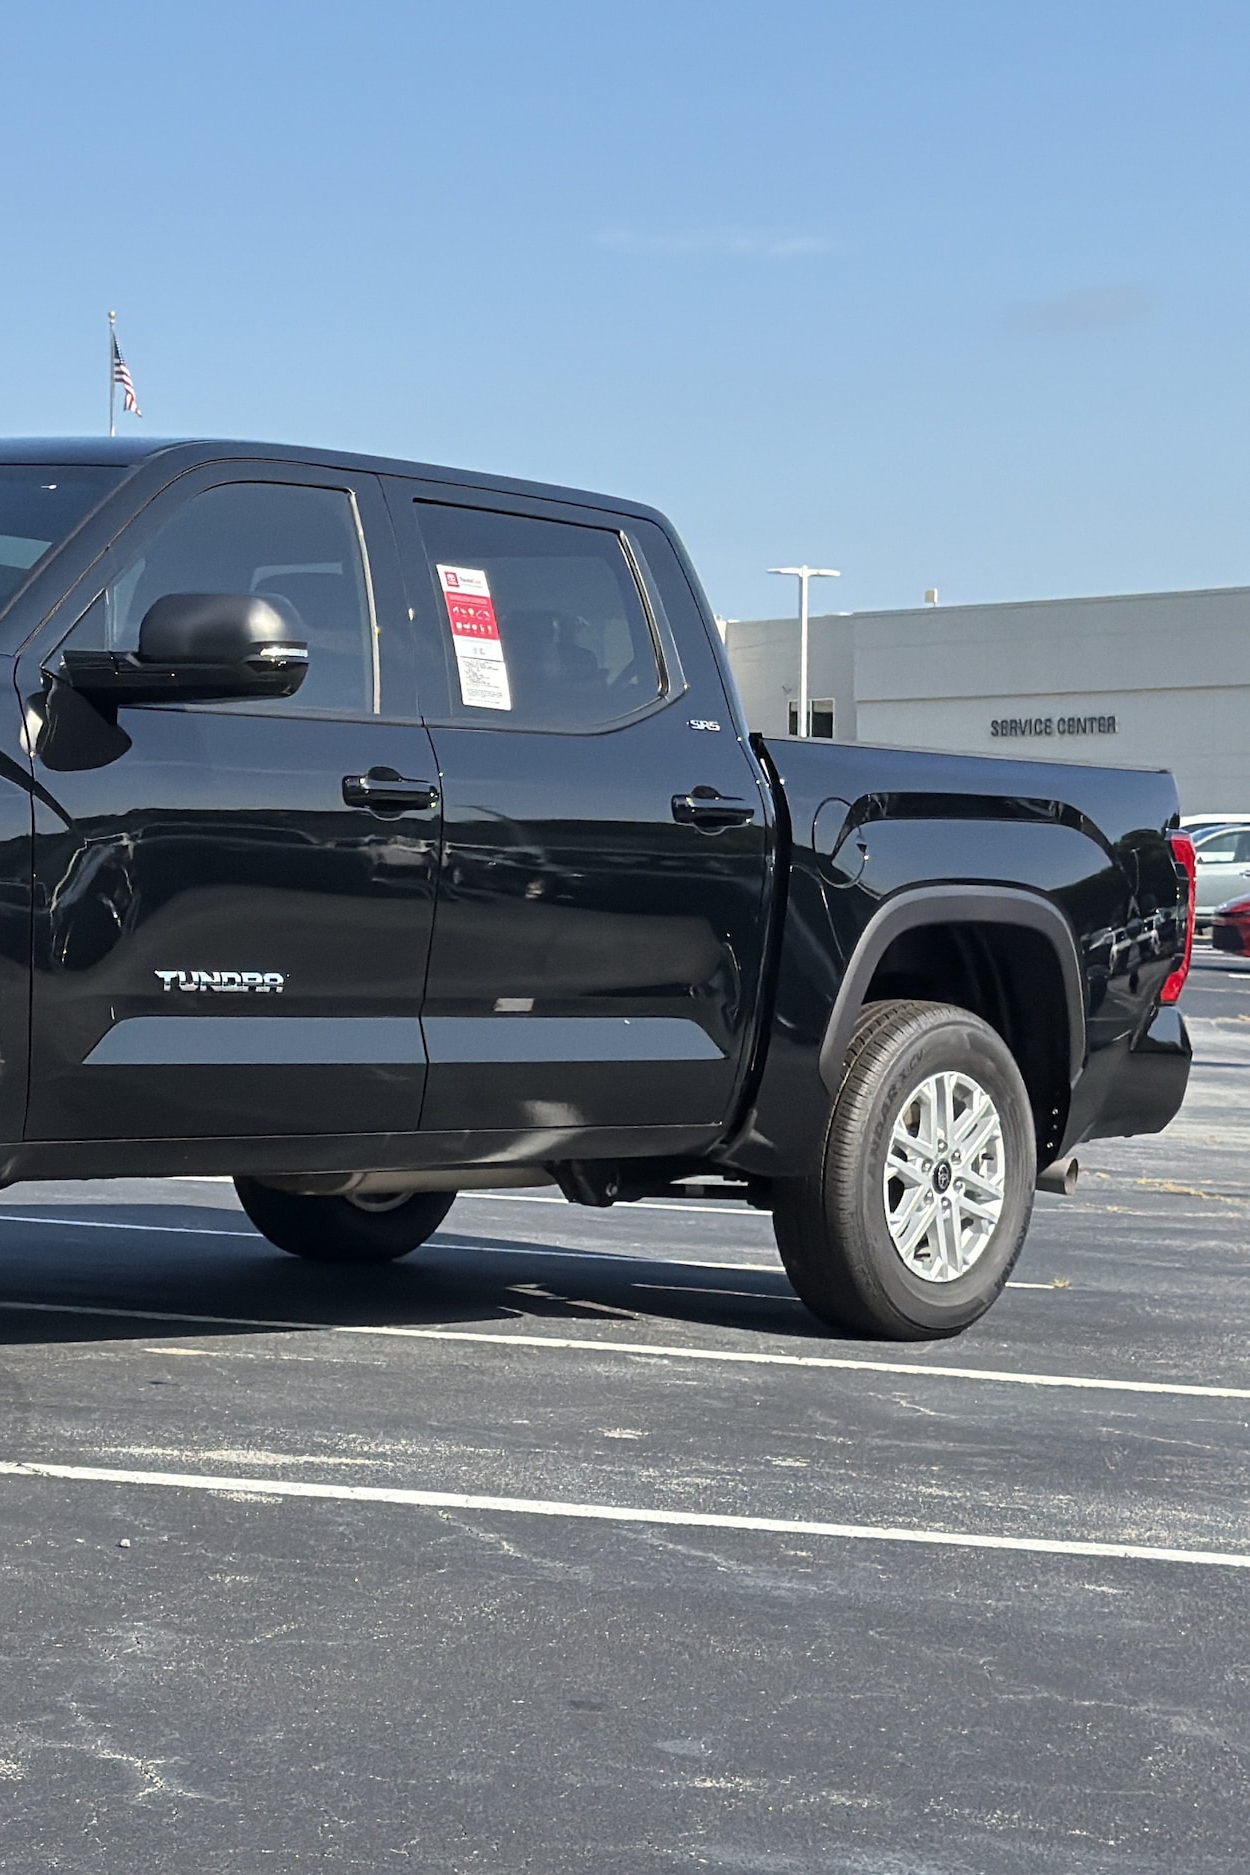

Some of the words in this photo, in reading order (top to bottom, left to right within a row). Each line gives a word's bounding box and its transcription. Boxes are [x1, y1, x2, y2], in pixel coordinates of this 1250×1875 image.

[990, 719, 1052, 737] SERVICE
[1057, 715, 1116, 735] CENTER
[154, 970, 285, 993] TUNDRA
